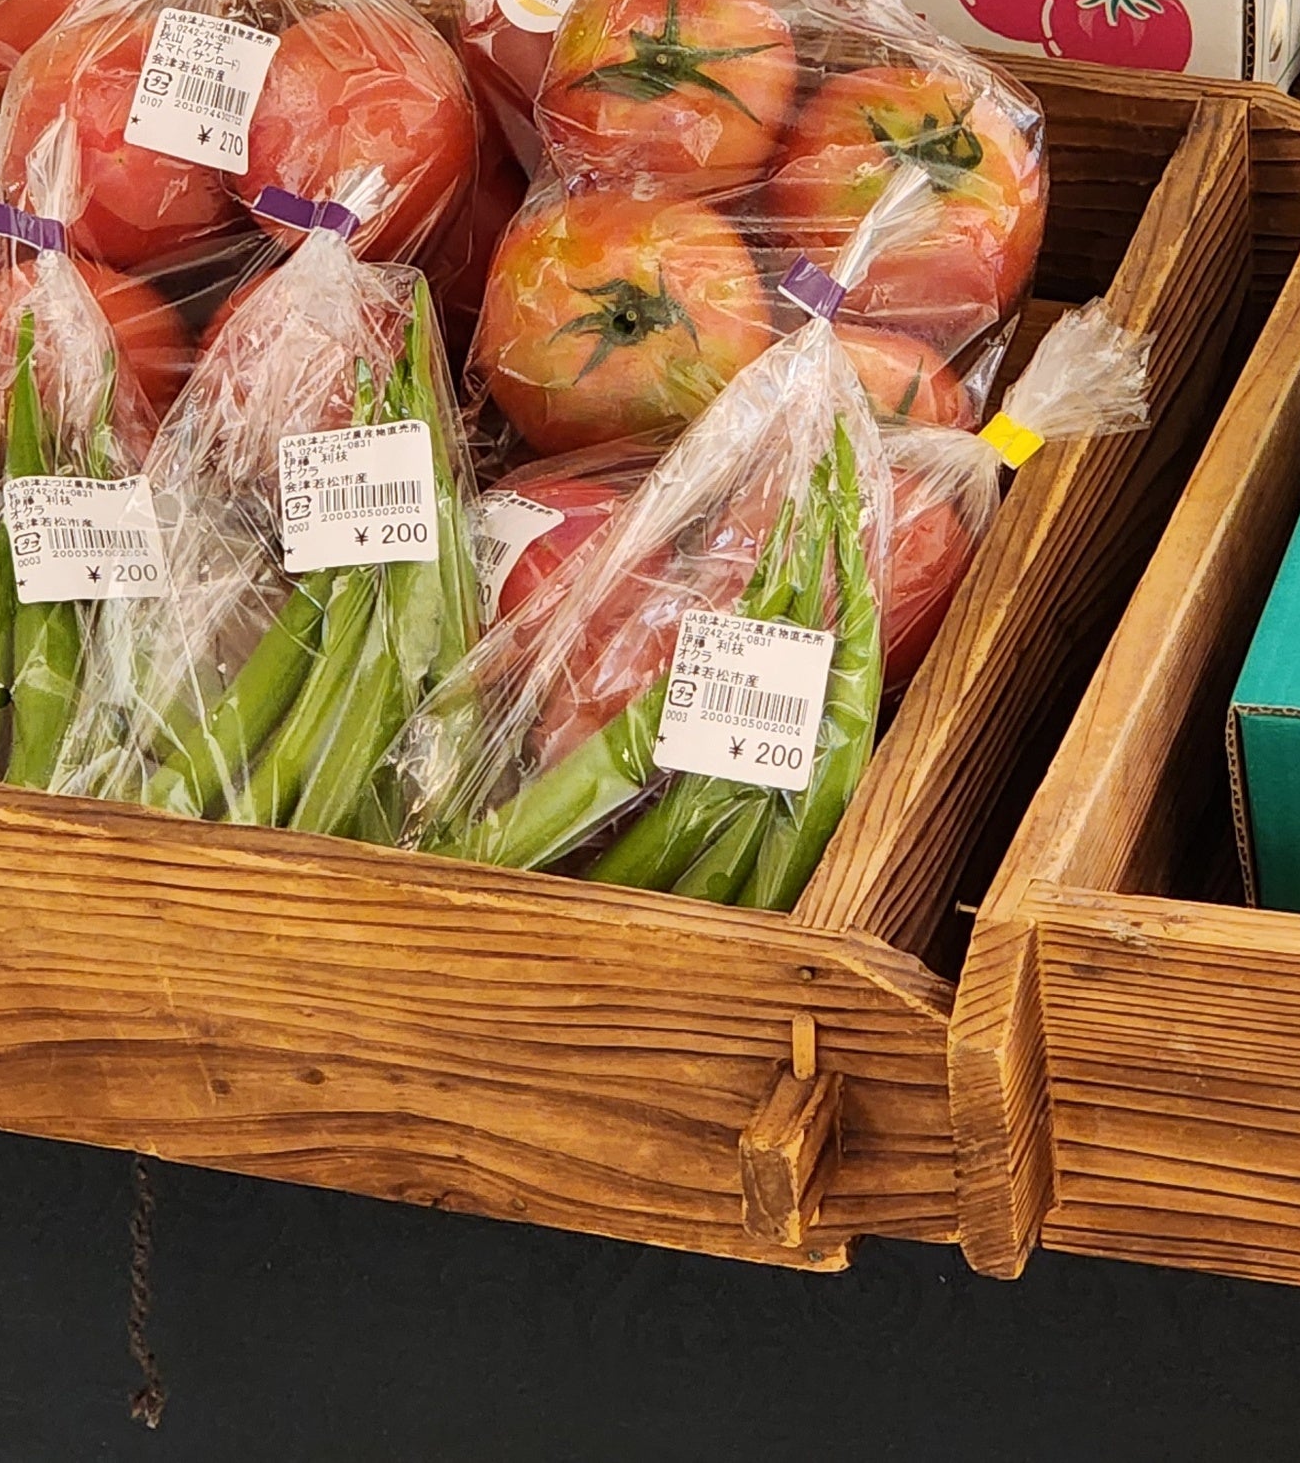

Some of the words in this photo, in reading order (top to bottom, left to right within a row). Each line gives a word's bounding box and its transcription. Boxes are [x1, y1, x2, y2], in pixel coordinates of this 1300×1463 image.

[164, 12, 275, 47] JA会津よつば農産物直売所
[193, 37, 225, 54] タケ子
[152, 53, 226, 82] 会津若松市産
[139, 94, 163, 109] 0107
[197, 124, 214, 145] ¥
[219, 130, 244, 157] 270
[282, 423, 422, 448] JA会津よつば農産物直売所
[299, 439, 372, 457] 0242-24-0831
[284, 466, 320, 480] オクラ
[285, 472, 367, 493] 会津若松市産
[7, 478, 140, 492] JA会津よつば農産物直売所
[10, 505, 45, 521] オクラ
[320, 505, 421, 523] 2000305002004
[13, 517, 94, 533] 会津若松市産
[287, 522, 310, 535] 0003
[354, 526, 369, 546] ¥
[381, 522, 428, 544] 200
[52, 549, 149, 558] 2000305002004
[85, 565, 102, 584] ¥
[114, 564, 158, 583] 200
[685, 612, 825, 647] JA会津よつば農産物直売所
[698, 625, 771, 647] 0242-24-0831
[678, 646, 713, 664] オクラ
[675, 661, 760, 688] 会津若松市産
[665, 708, 688, 723] 0003
[700, 710, 802, 737] 2000305002004
[728, 735, 746, 760] ¥
[755, 741, 804, 770] 200
